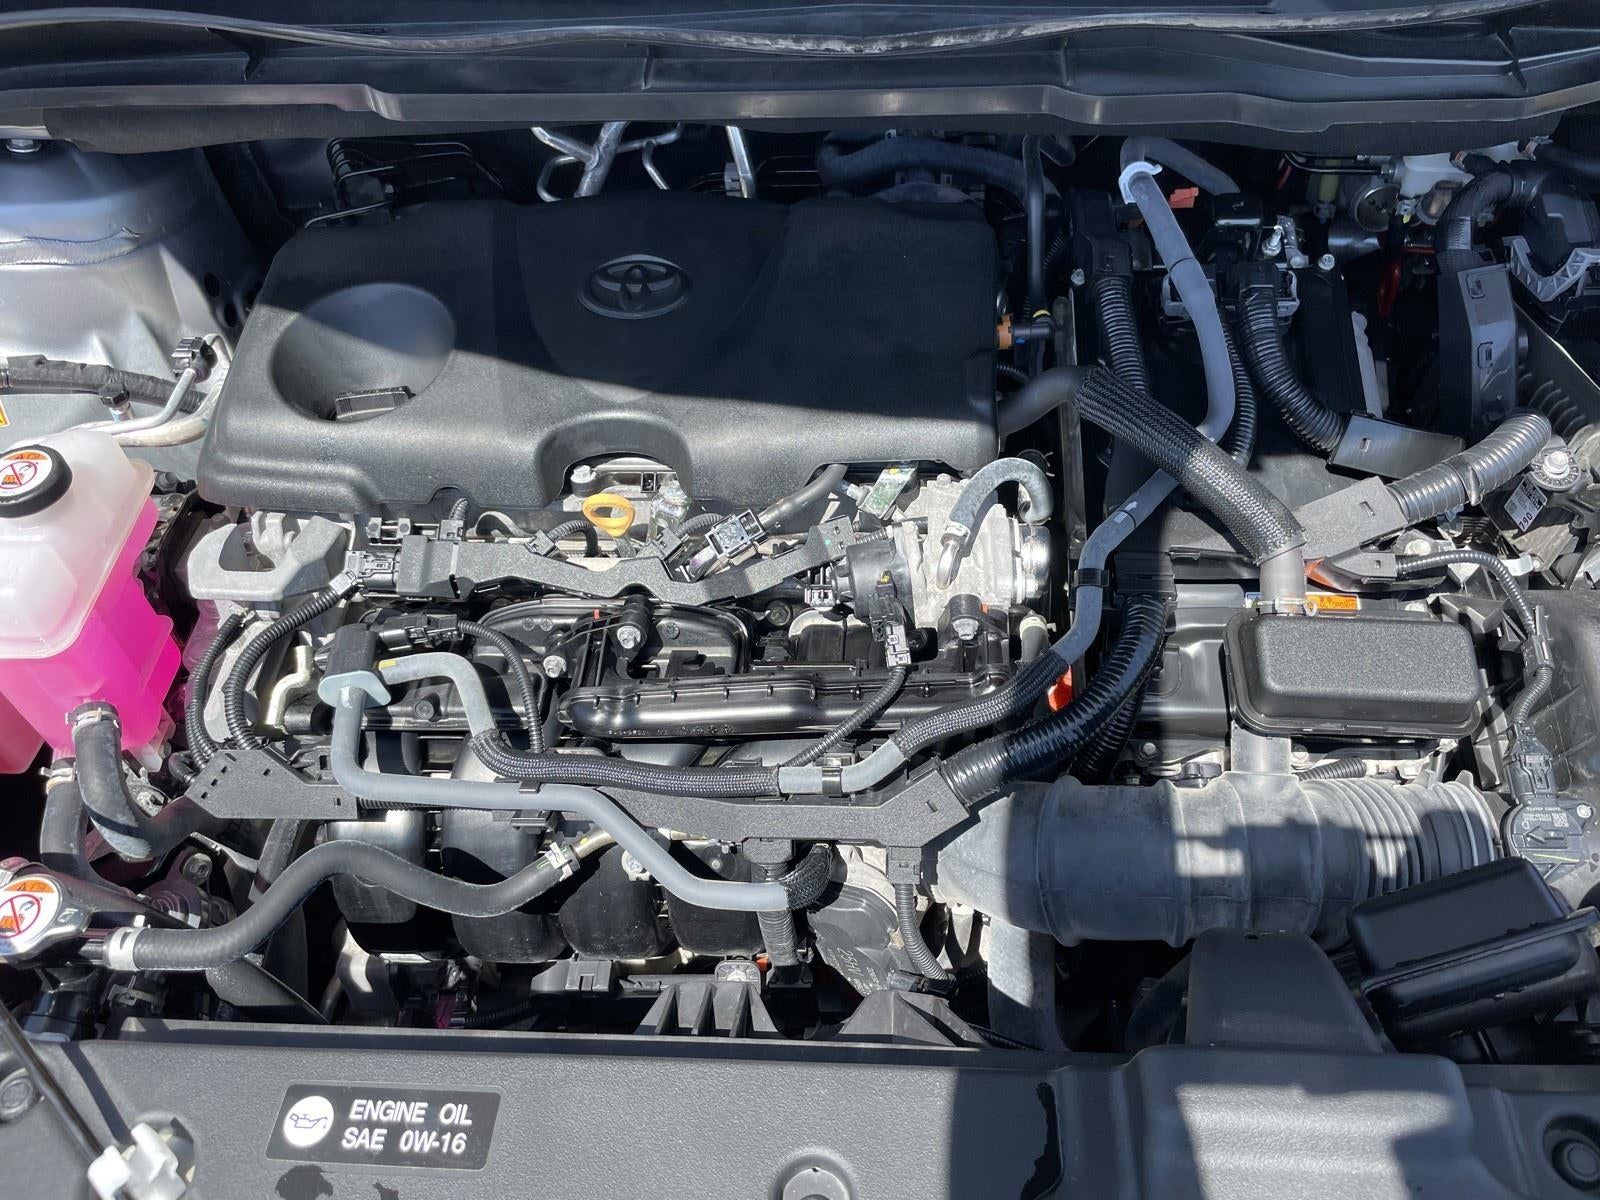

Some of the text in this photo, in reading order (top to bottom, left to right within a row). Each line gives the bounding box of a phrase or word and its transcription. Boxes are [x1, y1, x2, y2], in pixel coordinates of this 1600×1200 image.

[349, 1099, 472, 1126] ENGINE OIL
[341, 1127, 467, 1155] SAE 0W-16
